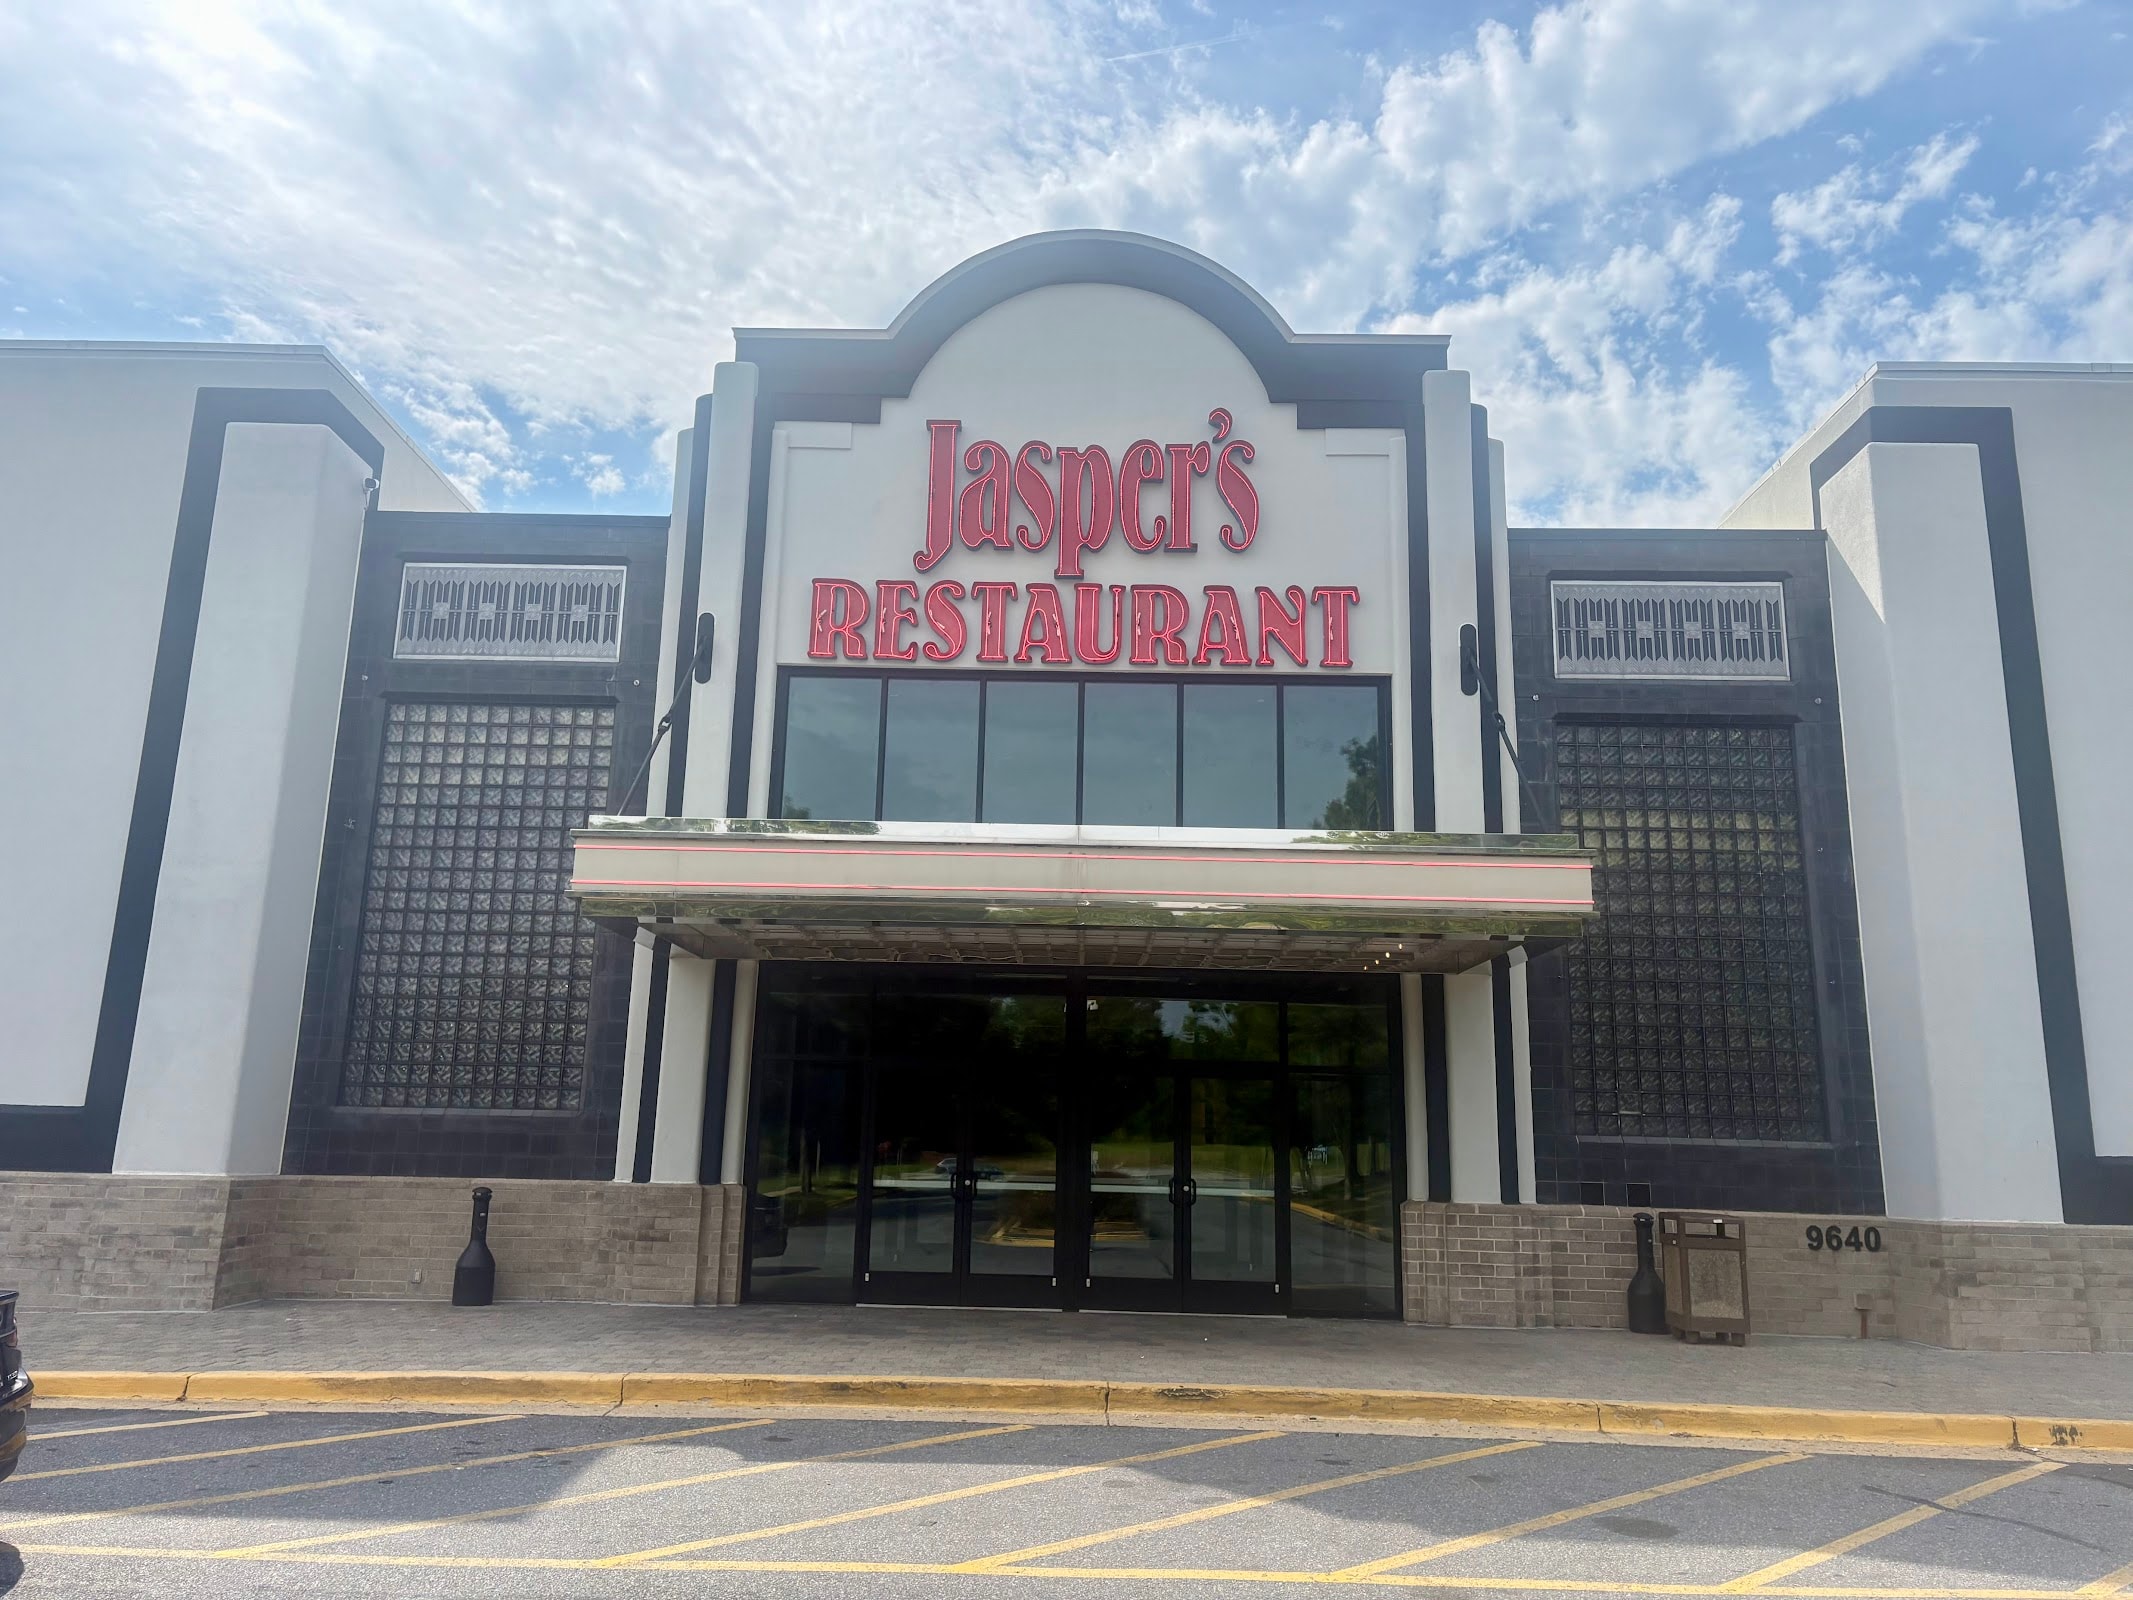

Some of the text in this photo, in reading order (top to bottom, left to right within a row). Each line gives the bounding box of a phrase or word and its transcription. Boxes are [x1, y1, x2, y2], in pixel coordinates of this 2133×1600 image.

[913, 407, 1260, 579] Jasper's
[807, 577, 1360, 668] RESTAURANT
[1806, 1225, 1881, 1252] 9640
